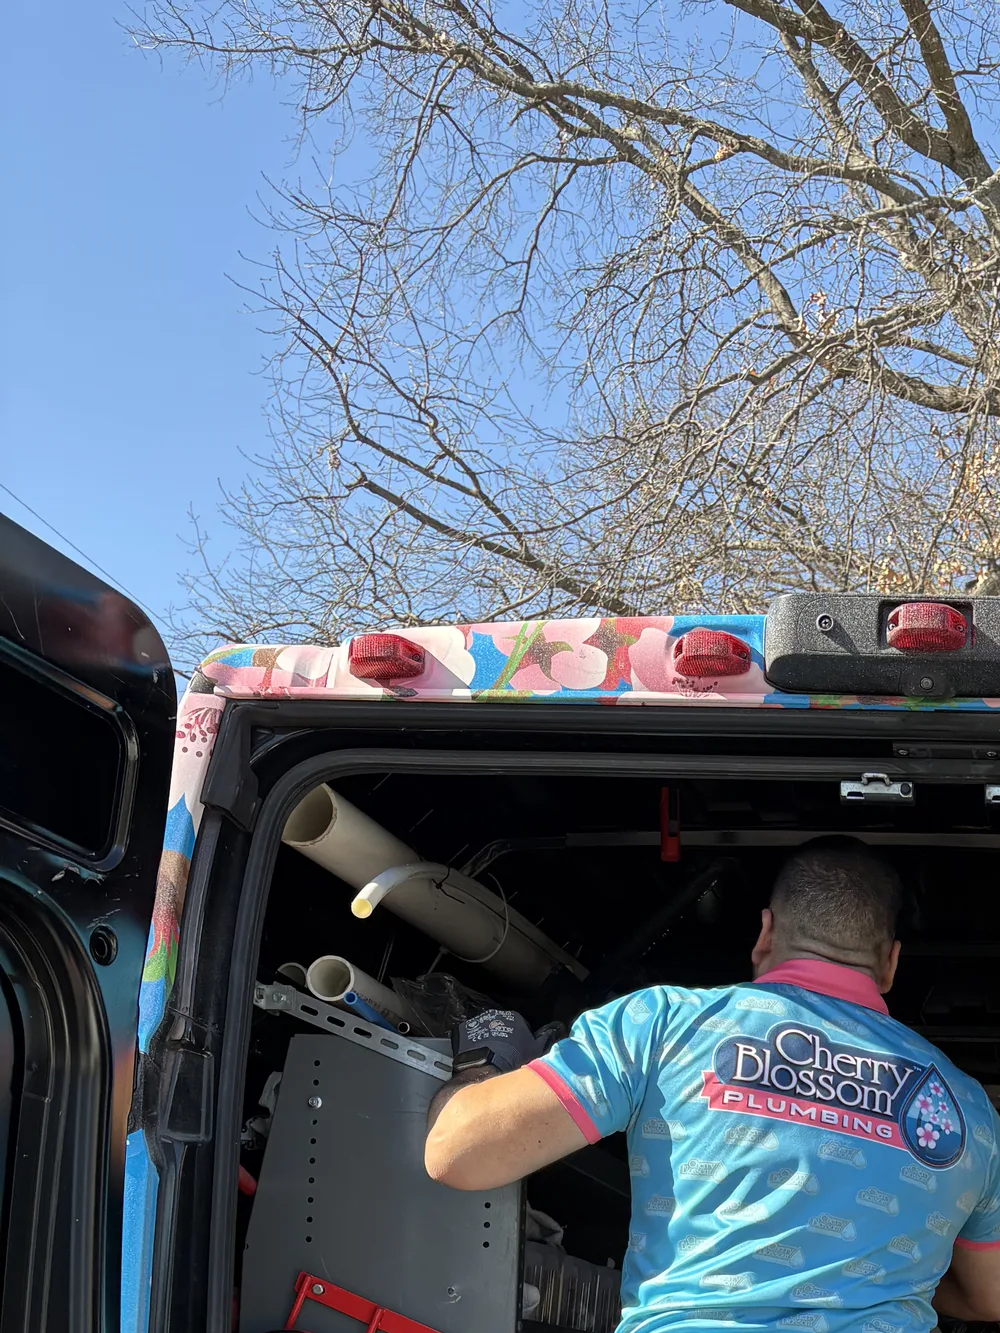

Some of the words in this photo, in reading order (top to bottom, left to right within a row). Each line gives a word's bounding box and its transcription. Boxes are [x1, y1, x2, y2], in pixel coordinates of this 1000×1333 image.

[732, 1042, 893, 1116] Blossom
[775, 1028, 914, 1099] Cherry
[723, 1090, 893, 1139] PLUMBING
